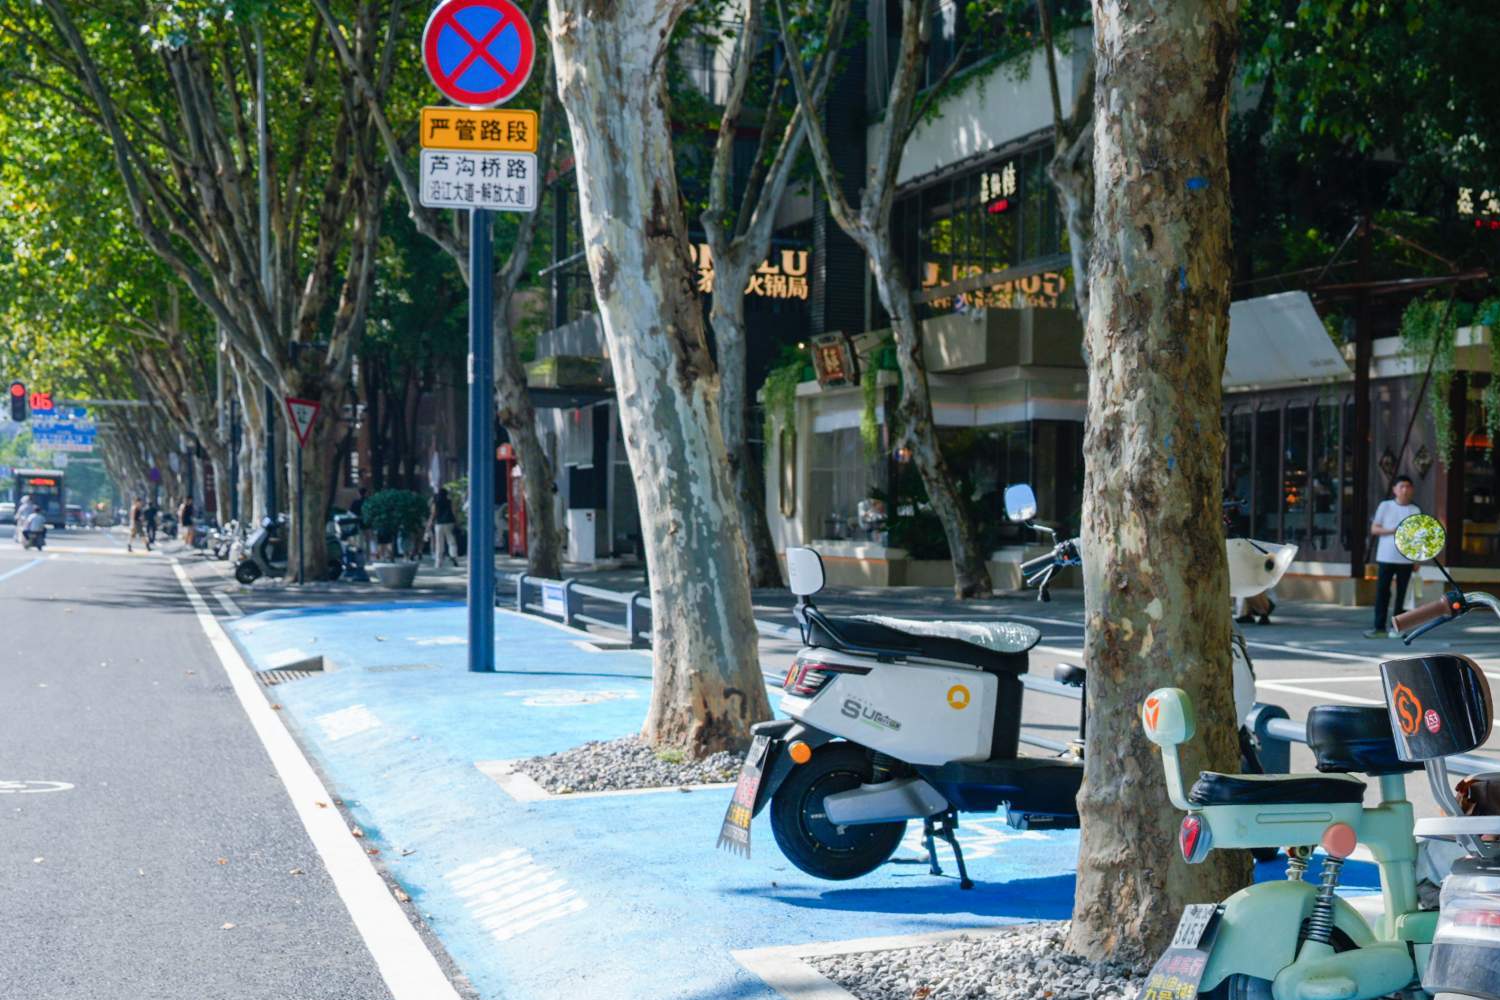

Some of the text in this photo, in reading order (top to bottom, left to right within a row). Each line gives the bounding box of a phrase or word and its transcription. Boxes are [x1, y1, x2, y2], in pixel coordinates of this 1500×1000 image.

[430, 118, 528, 142] 严管路段
[430, 156, 527, 179] 芦沟桥路
